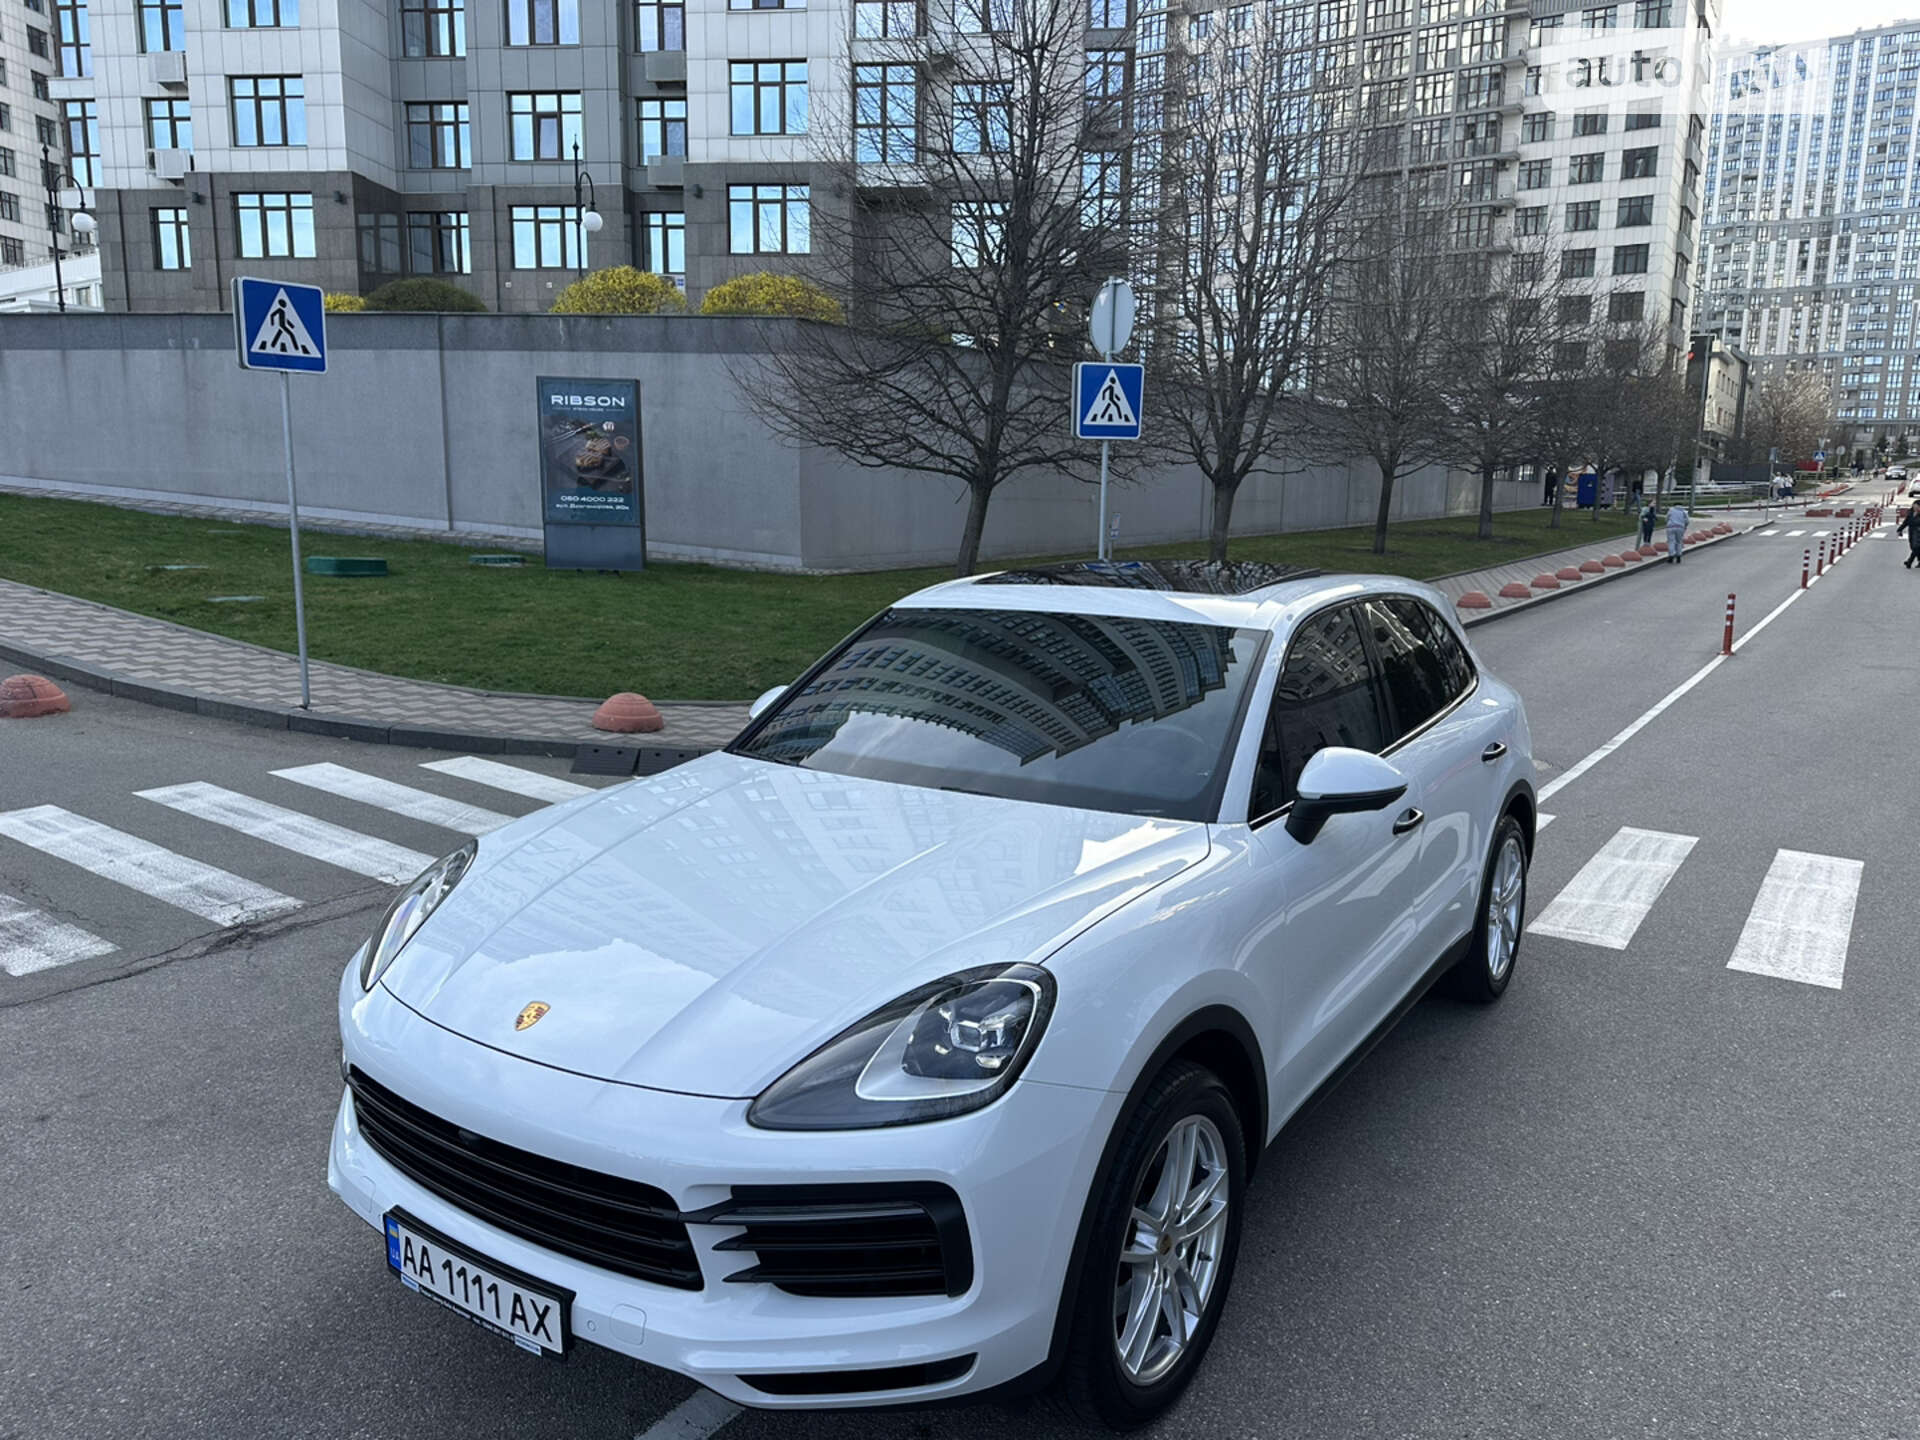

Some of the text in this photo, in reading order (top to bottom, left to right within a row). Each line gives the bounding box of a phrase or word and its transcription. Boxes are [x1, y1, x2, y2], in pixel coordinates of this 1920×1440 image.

[551, 395, 625, 407] RIBSON
[403, 1236, 435, 1284] AA
[441, 1259, 501, 1319] 1111
[510, 1293, 553, 1342] AX
